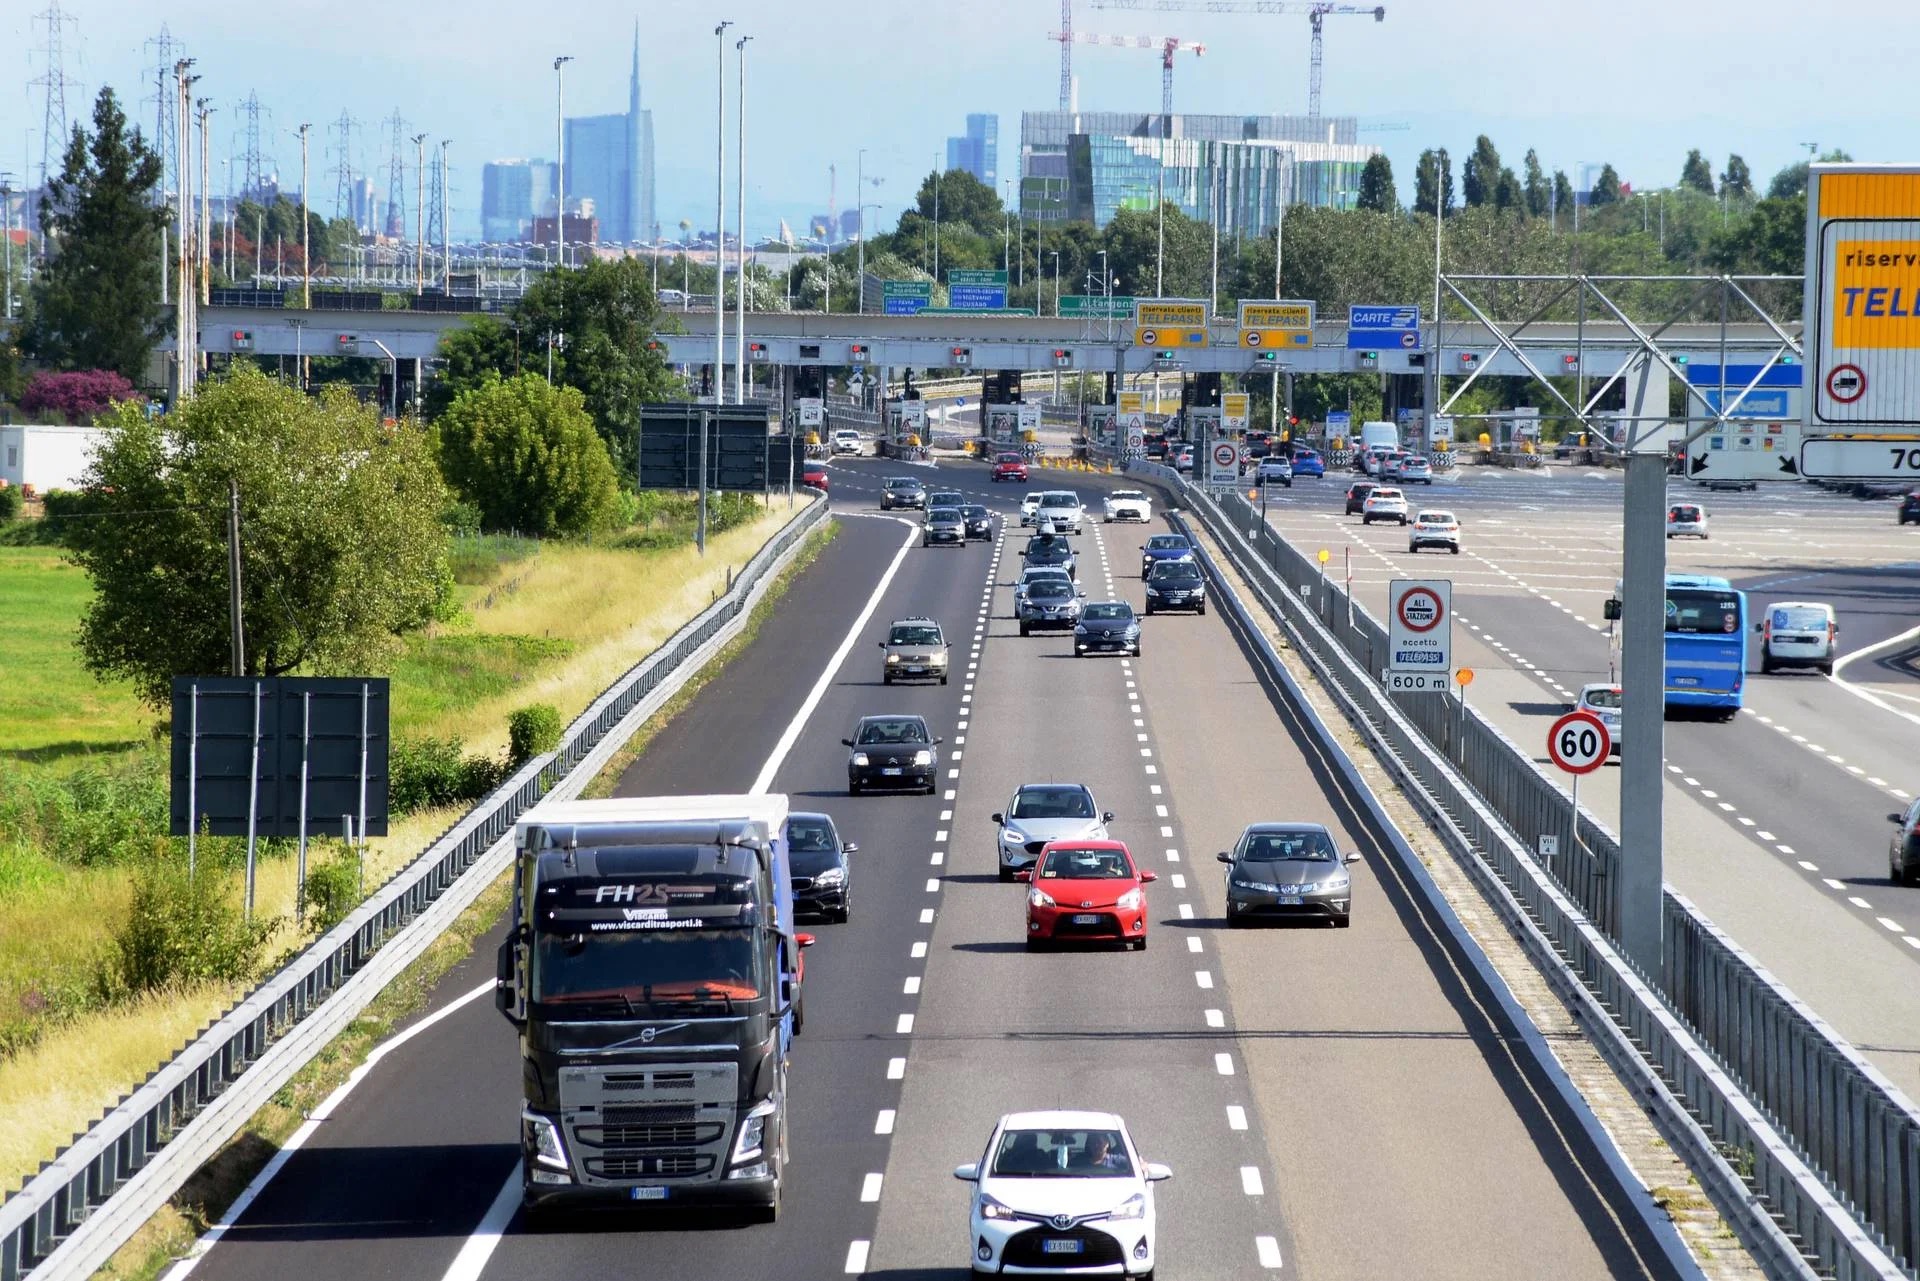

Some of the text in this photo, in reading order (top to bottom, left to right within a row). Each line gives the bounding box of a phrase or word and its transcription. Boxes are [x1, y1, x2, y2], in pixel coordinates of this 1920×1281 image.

[1846, 250, 1920, 267] riserv
[1142, 314, 1202, 324] TELEPASS
[1245, 315, 1307, 325] TELEPASS
[1353, 312, 1391, 323] CARTE
[1413, 599, 1425, 607] ALT
[1406, 612, 1434, 620] STAZIONE
[1400, 652, 1440, 662] TELEPASS
[1393, 676, 1445, 688] 600 m
[1561, 729, 1597, 758] 60
[591, 919, 703, 931] www.viscarditrasporti.it
